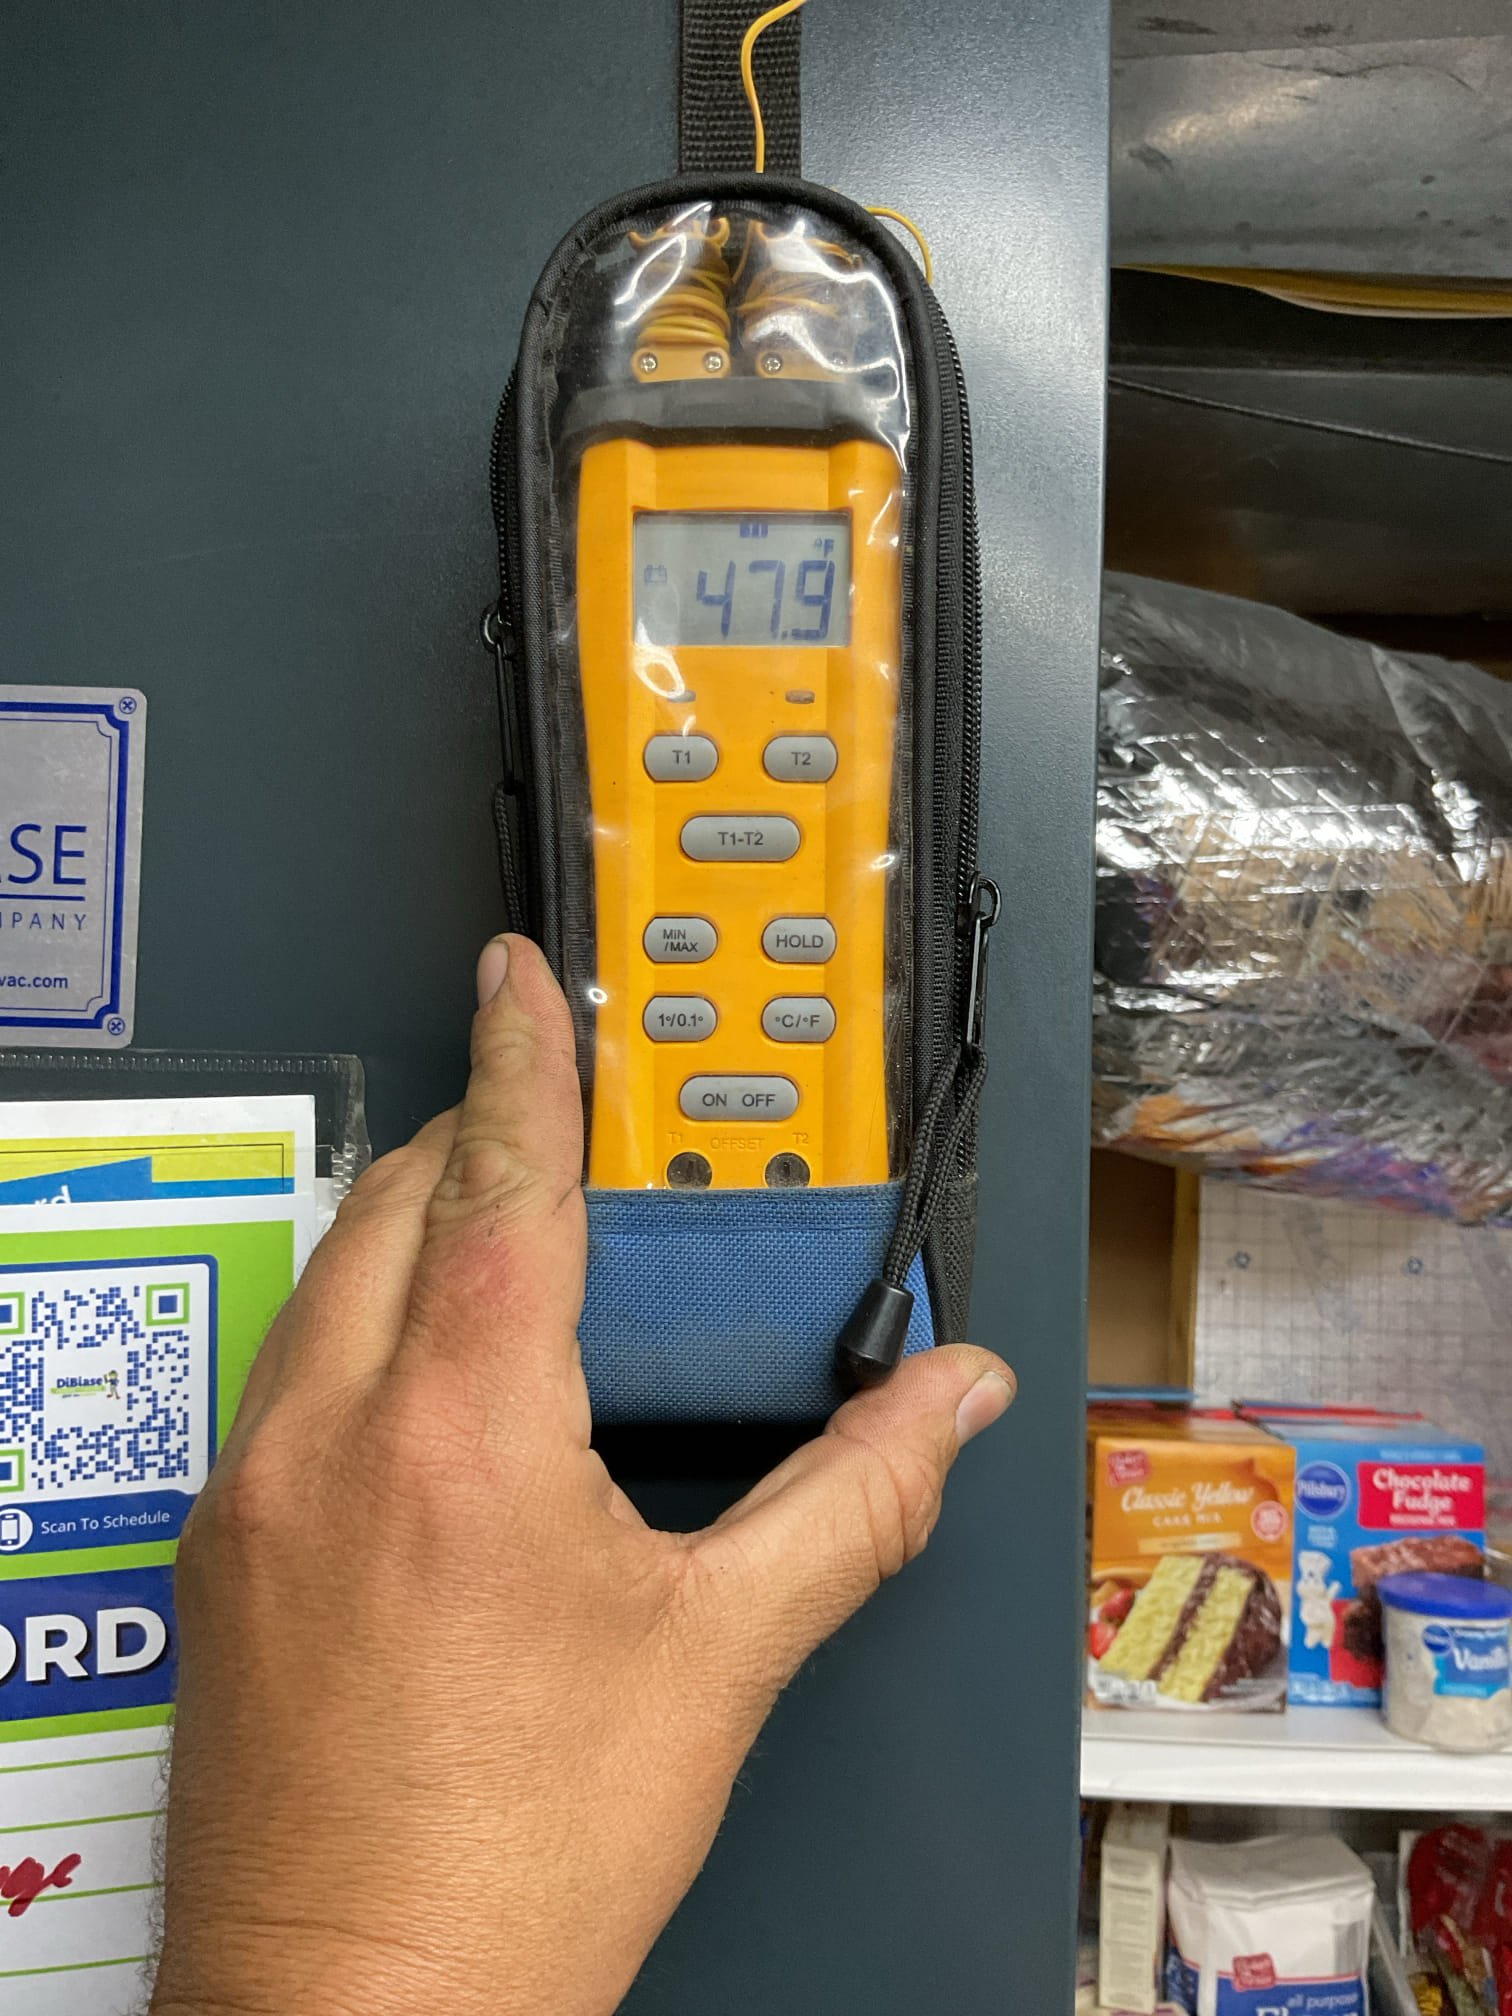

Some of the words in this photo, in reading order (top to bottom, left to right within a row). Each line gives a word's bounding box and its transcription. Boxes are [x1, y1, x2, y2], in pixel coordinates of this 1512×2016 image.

[696, 560, 836, 640] 47.9
[672, 750, 691, 765] T1
[791, 751, 811, 766] T2
[718, 831, 764, 847] T1-T2
[0, 823, 87, 886] SE
[0, 912, 87, 931] PANY
[662, 928, 686, 941] MIN
[776, 934, 824, 949] HOLD
[665, 941, 699, 953] /MAX
[702, 1093, 728, 1108] ON
[742, 1093, 776, 1108] OFF
[667, 1131, 683, 1144] T1
[710, 1137, 765, 1150] OFFSET
[792, 1132, 809, 1145] T2
[56, 1376, 103, 1389] DiBiase
[1373, 1467, 1472, 1492] Chocolate
[1121, 1486, 1187, 1513] Classic
[1191, 1481, 1255, 1513] Yellow
[1296, 1480, 1347, 1500] Pillsbury
[1392, 1489, 1454, 1516] Fudge
[41, 1521, 77, 1535] Scan
[80, 1517, 100, 1531] To
[103, 1510, 170, 1529] Schedule
